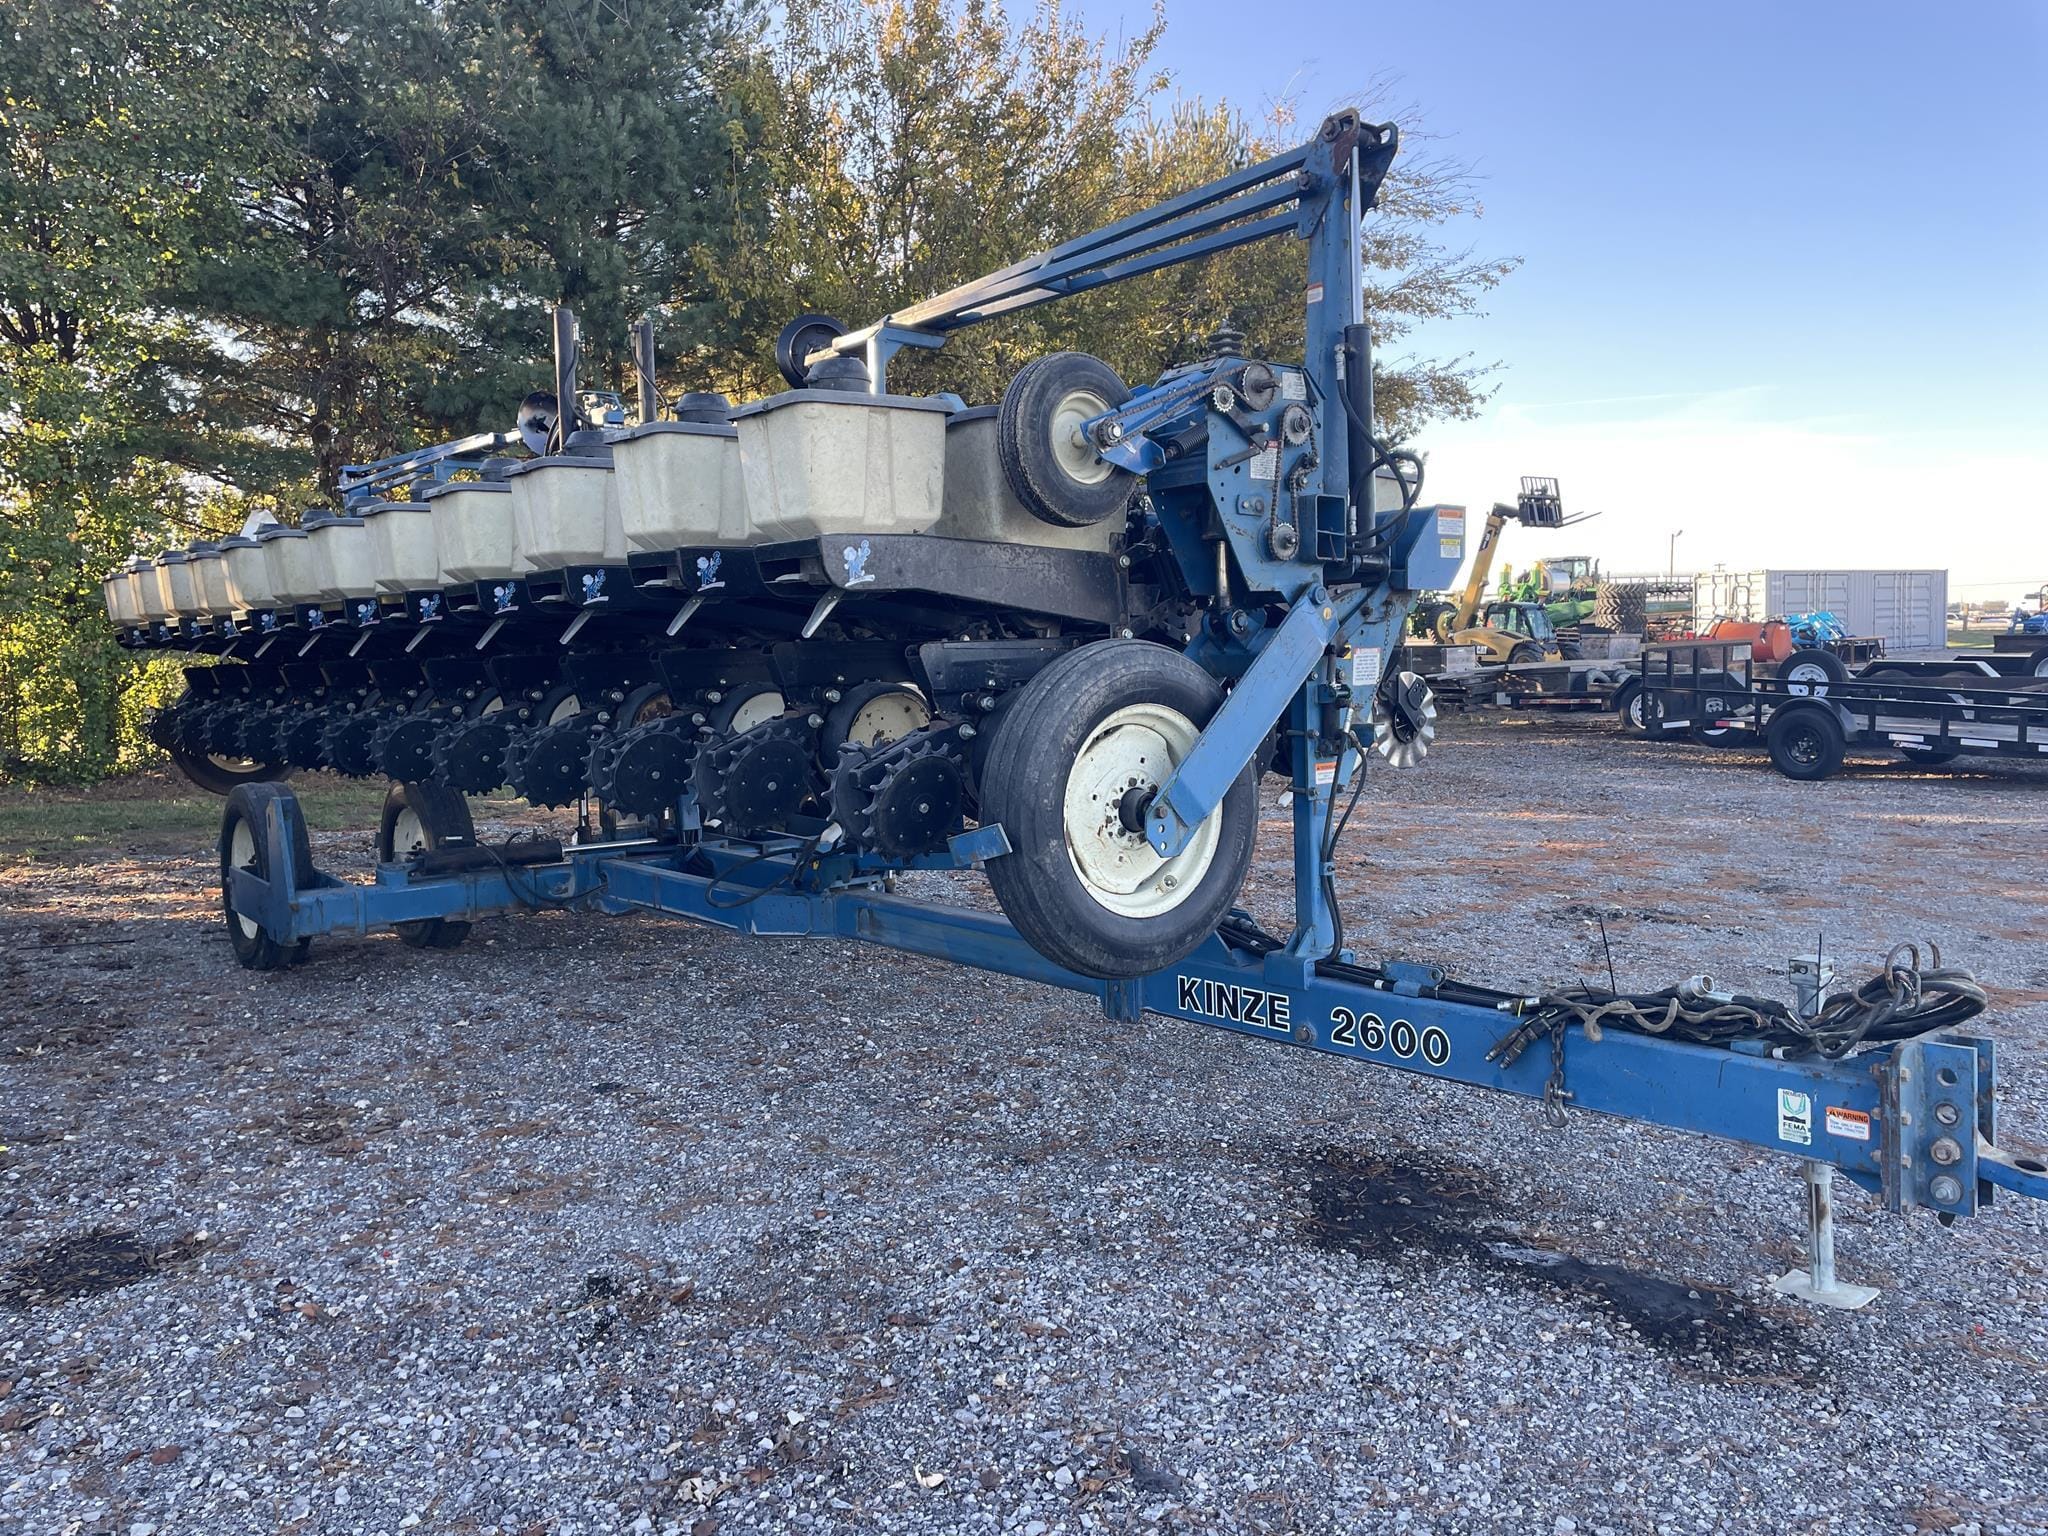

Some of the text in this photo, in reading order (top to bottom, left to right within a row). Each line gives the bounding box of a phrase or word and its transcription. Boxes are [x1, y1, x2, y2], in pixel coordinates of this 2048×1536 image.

[1177, 975, 1451, 1067] KINZE 2600
[1837, 1110, 1869, 1123] WARNING
[1783, 1121, 1806, 1132] FEMA
